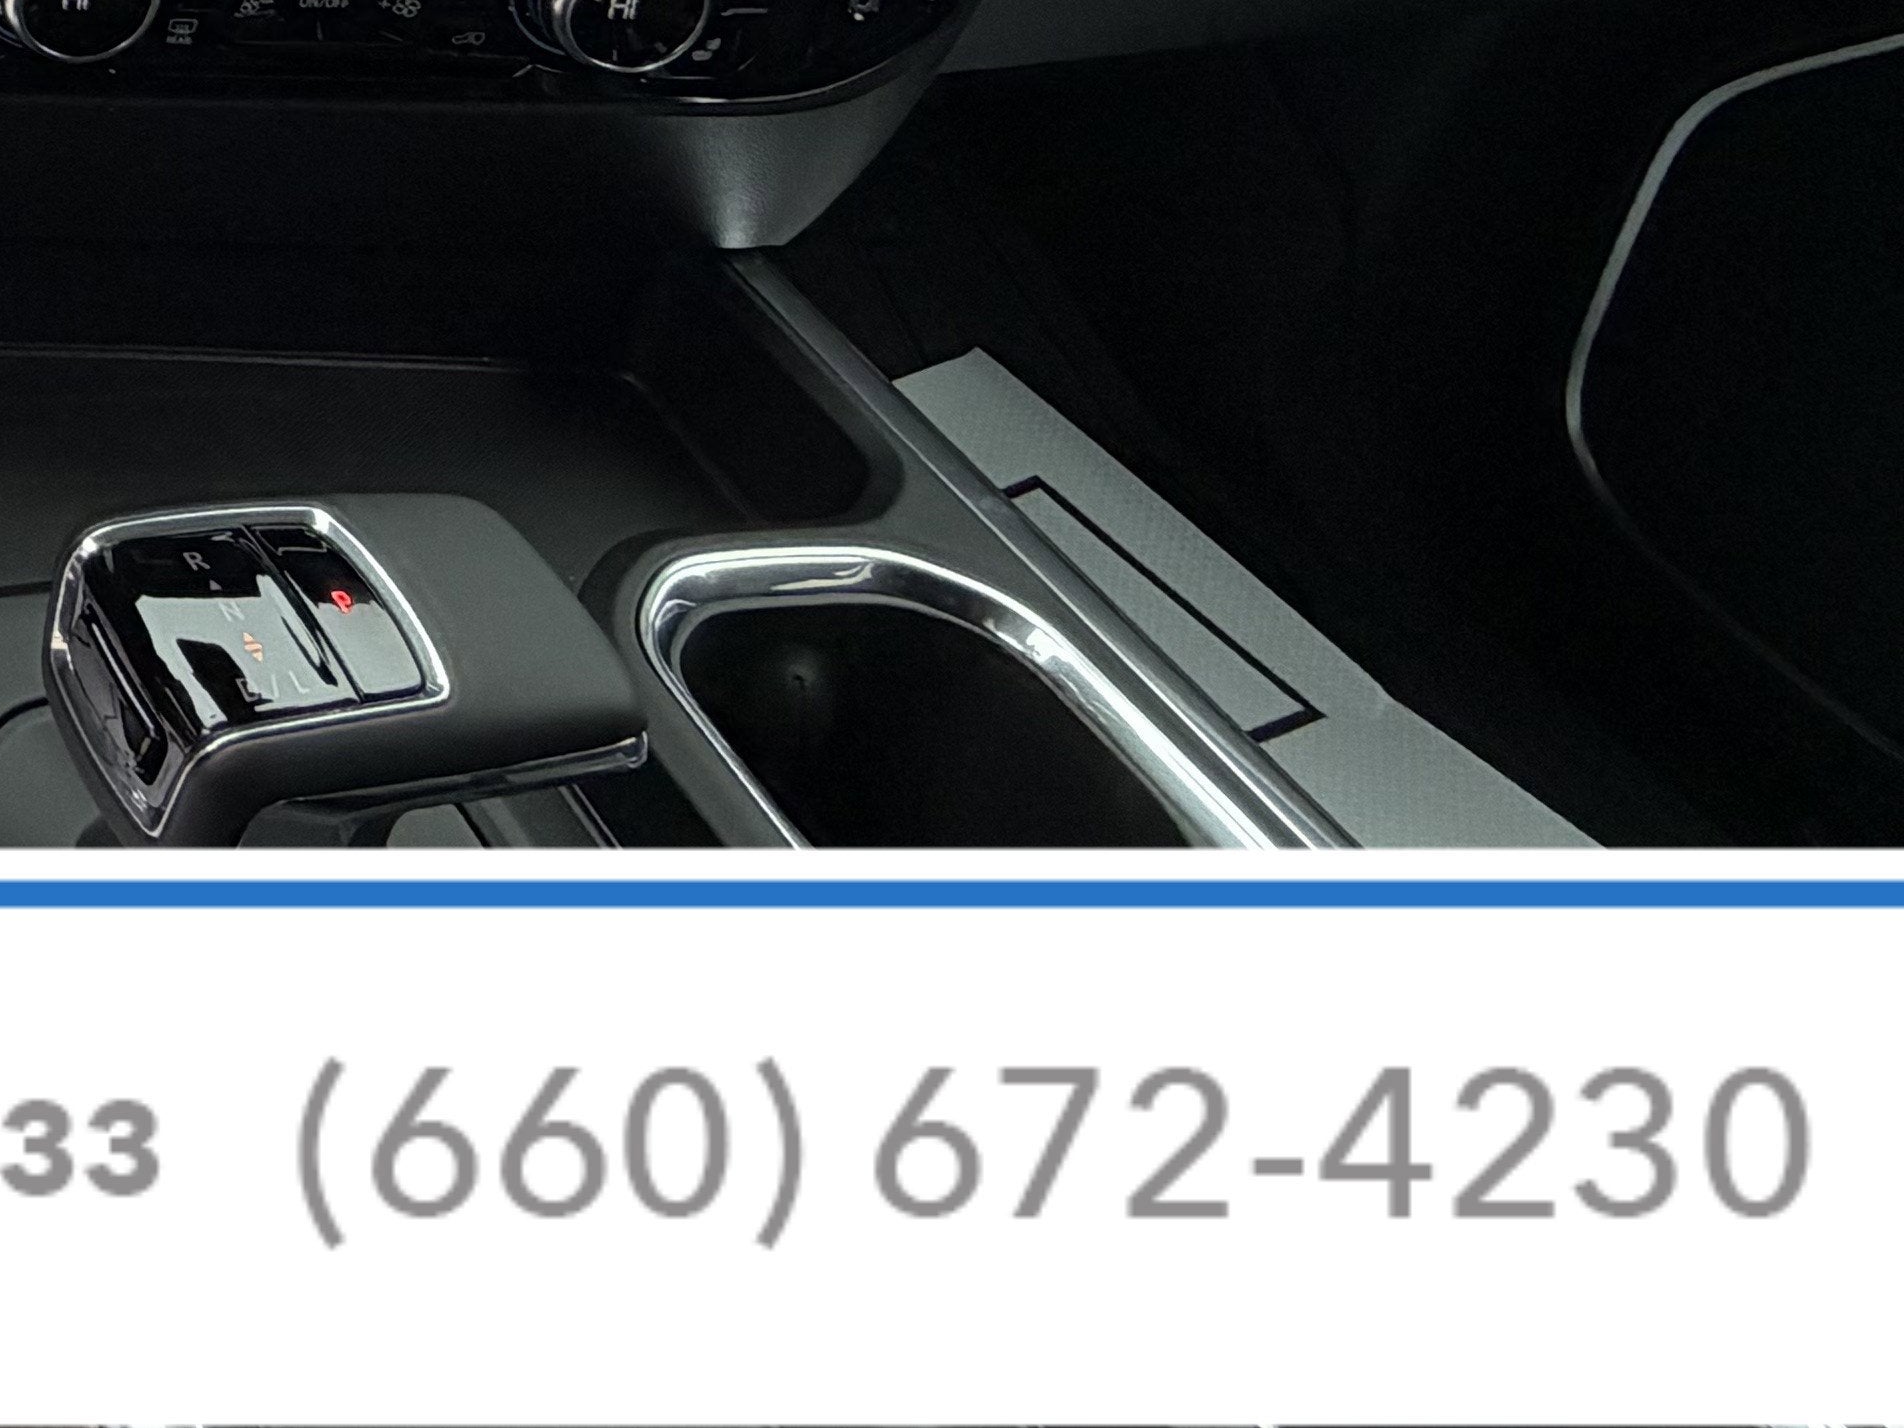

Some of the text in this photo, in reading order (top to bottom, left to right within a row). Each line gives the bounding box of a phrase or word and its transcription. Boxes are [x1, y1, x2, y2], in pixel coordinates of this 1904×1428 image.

[182, 551, 211, 572] R
[218, 601, 246, 622] N
[330, 590, 352, 613] P
